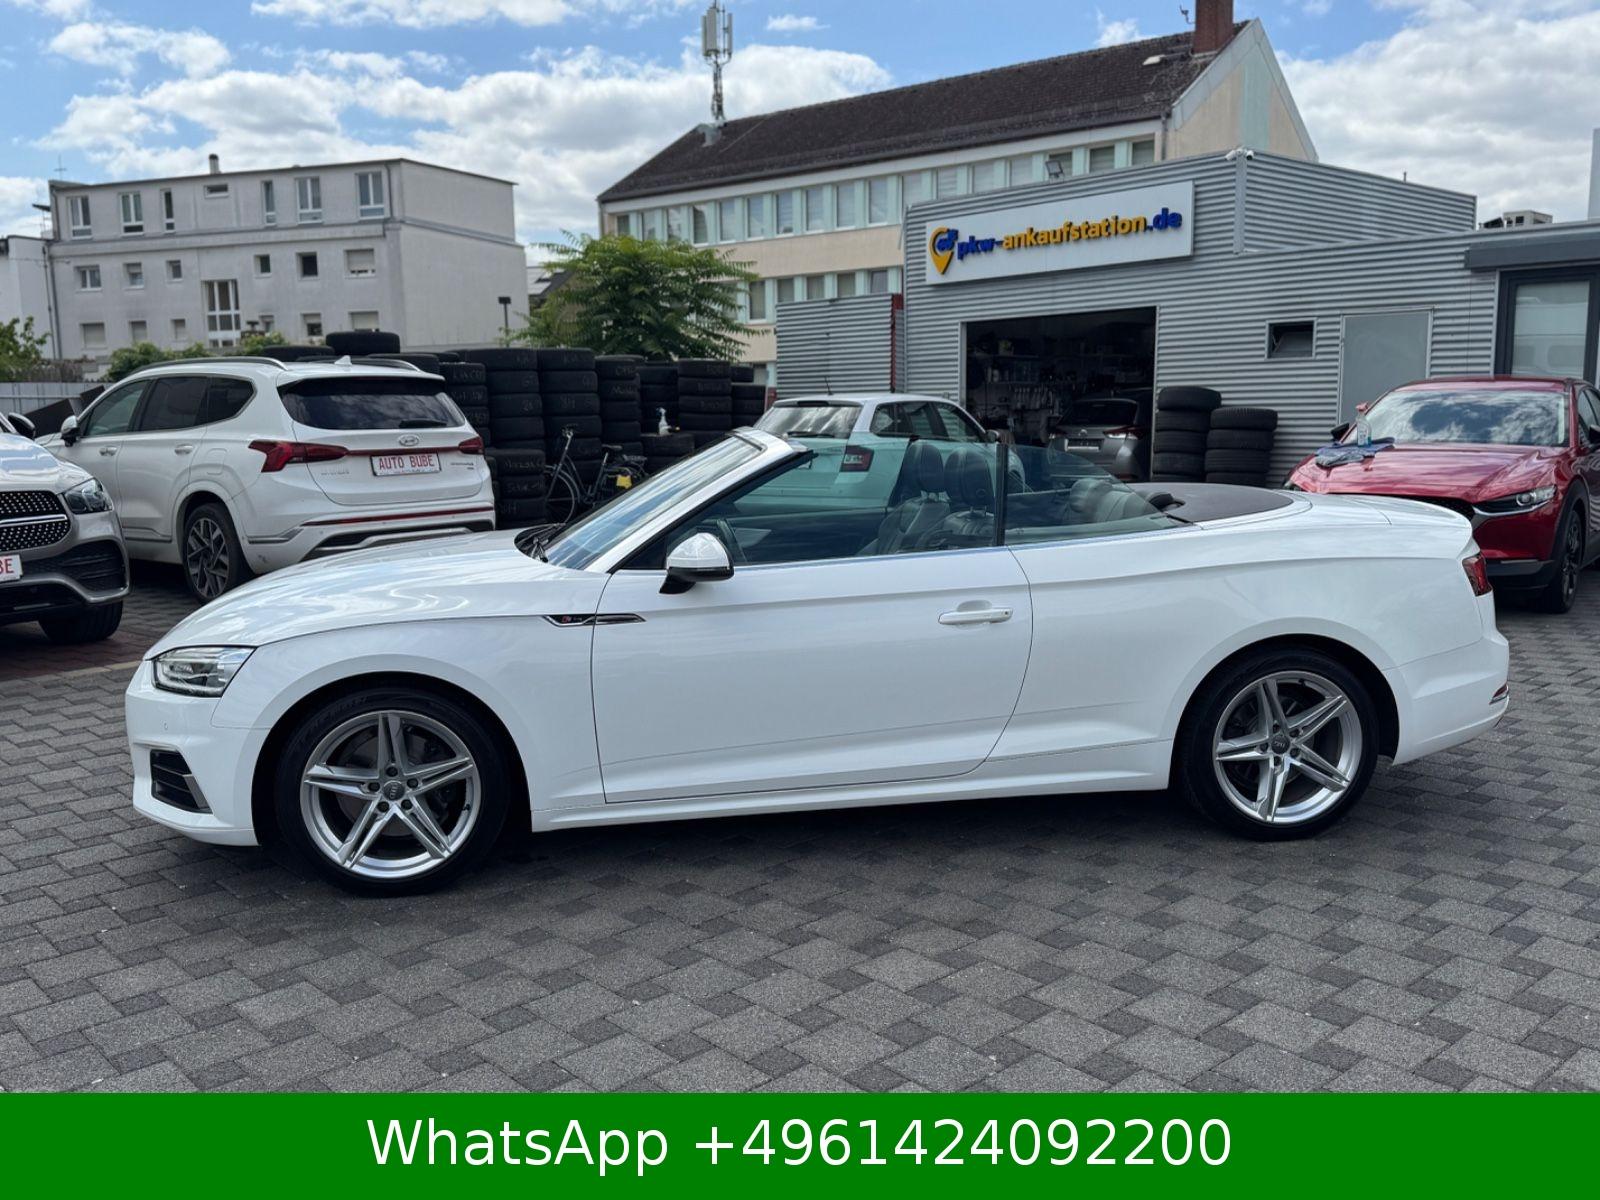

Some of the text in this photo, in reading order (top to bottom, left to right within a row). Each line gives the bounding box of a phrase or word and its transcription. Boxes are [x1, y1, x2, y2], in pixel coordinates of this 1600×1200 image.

[957, 207, 1183, 260] pkw-ankaufstation.de
[379, 456, 404, 470] AUTO
[410, 455, 434, 468] BUBE
